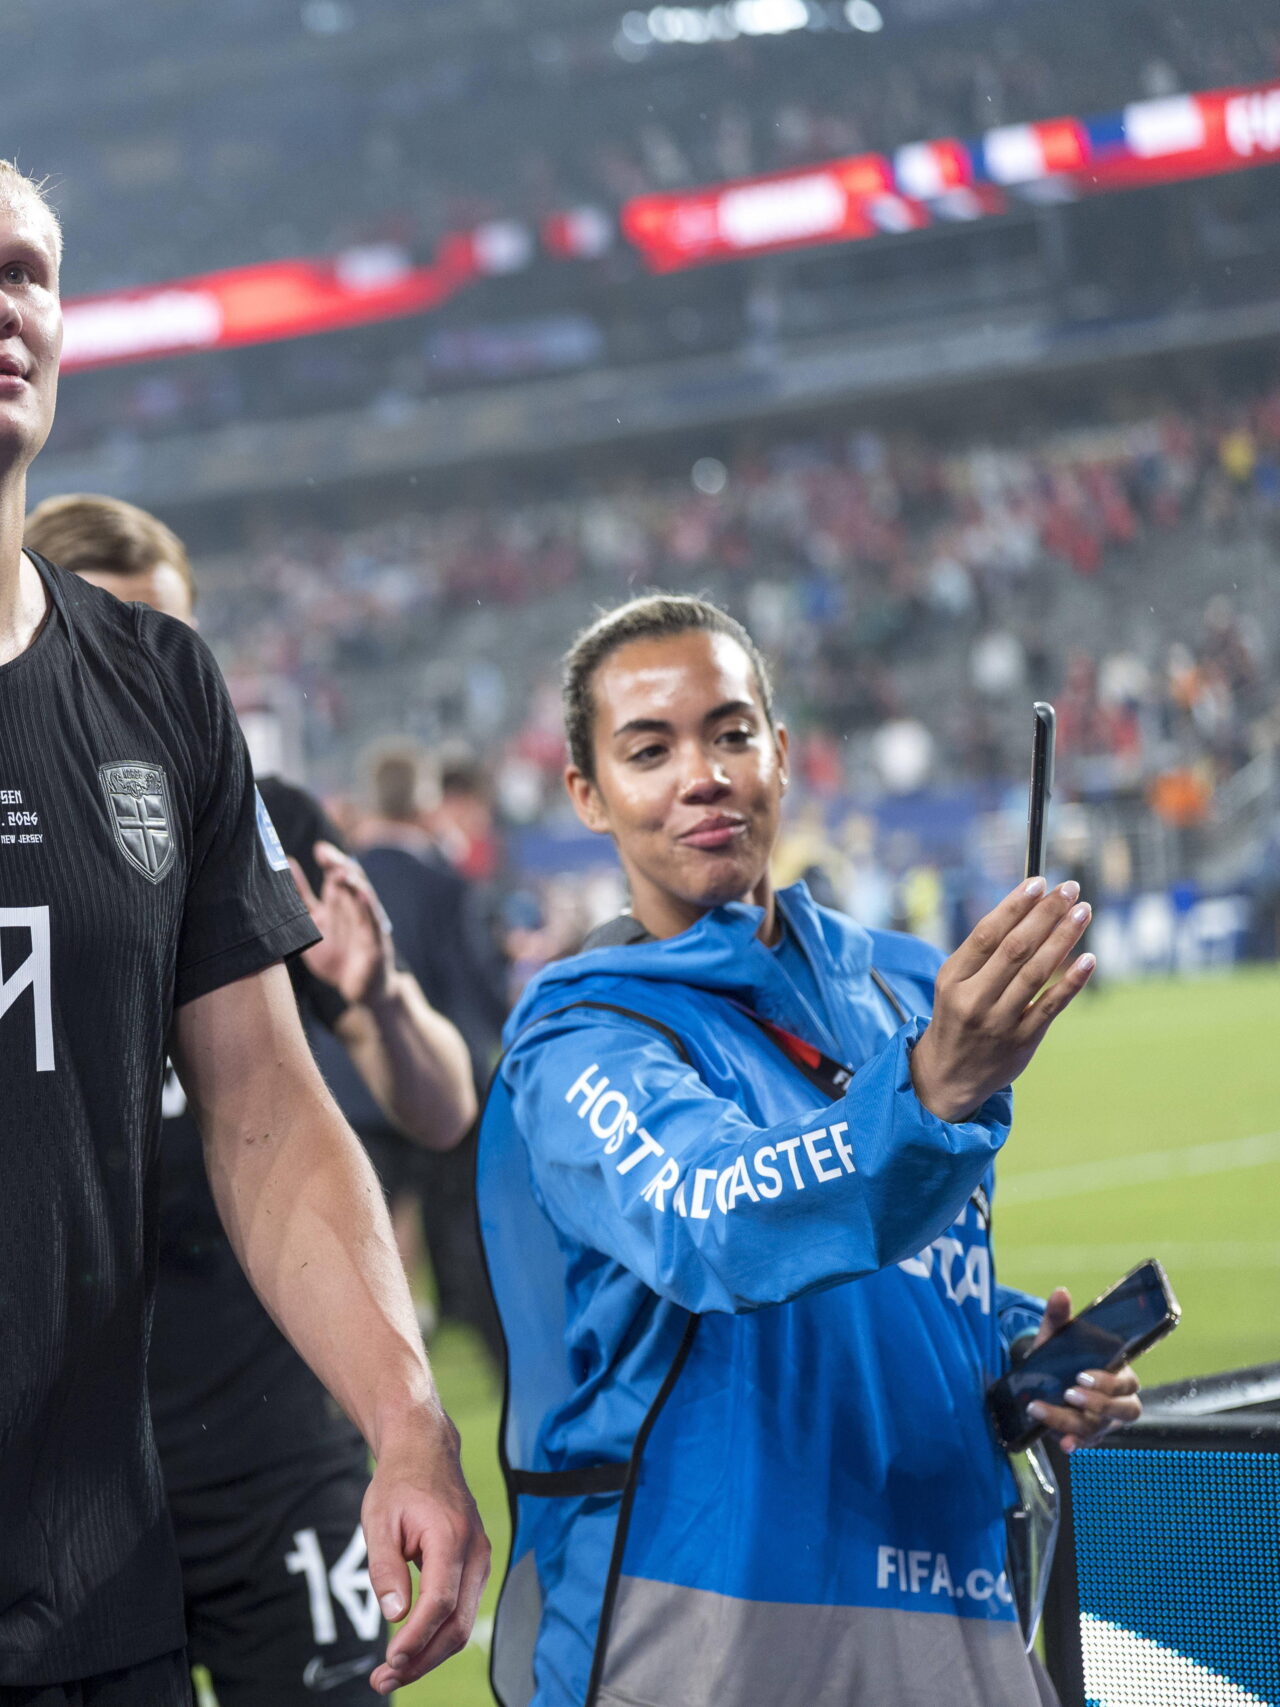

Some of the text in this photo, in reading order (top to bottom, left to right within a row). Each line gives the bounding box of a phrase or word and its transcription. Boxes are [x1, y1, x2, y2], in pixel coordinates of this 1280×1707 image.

[0, 834, 16, 844] NEW
[17, 833, 44, 844] JERSEY
[565, 1063, 665, 1176] HOST
[284, 1523, 382, 1645] 16
